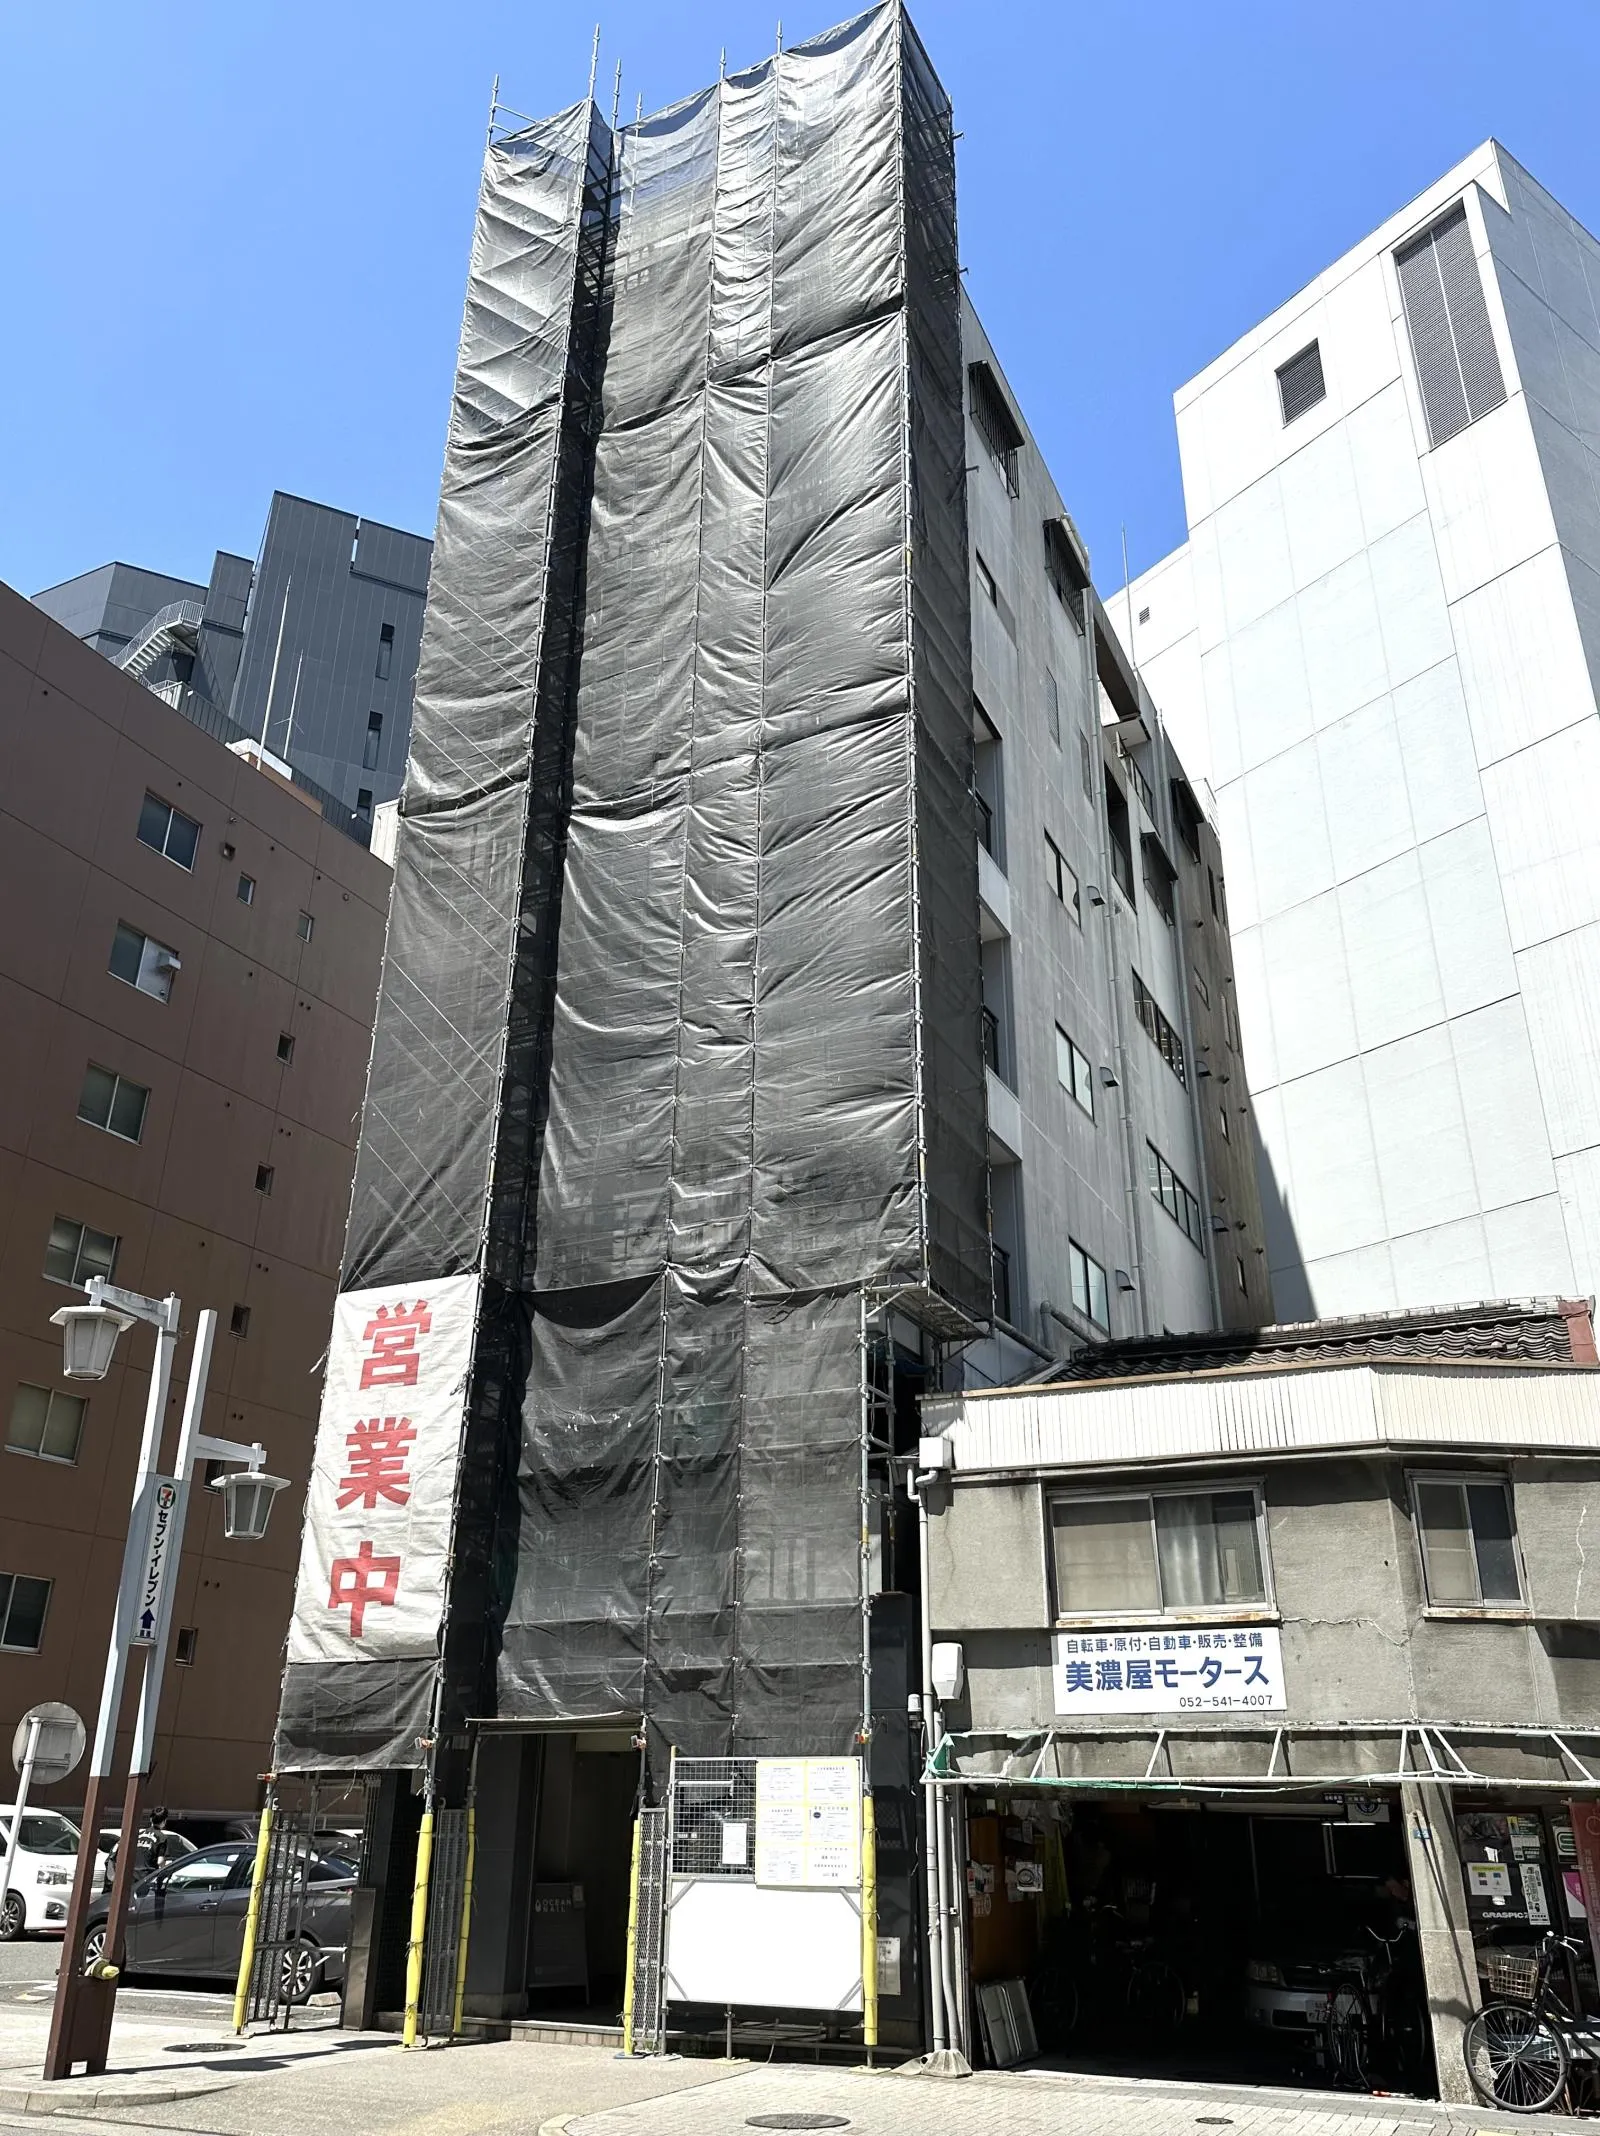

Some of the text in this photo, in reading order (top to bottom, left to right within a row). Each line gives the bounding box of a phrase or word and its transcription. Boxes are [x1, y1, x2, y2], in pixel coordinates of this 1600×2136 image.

[328, 1299, 432, 1638] 営業中
[1066, 1655, 1269, 1692] 美濃屋モータース
[1180, 1695, 1273, 1708] 052-541-4007
